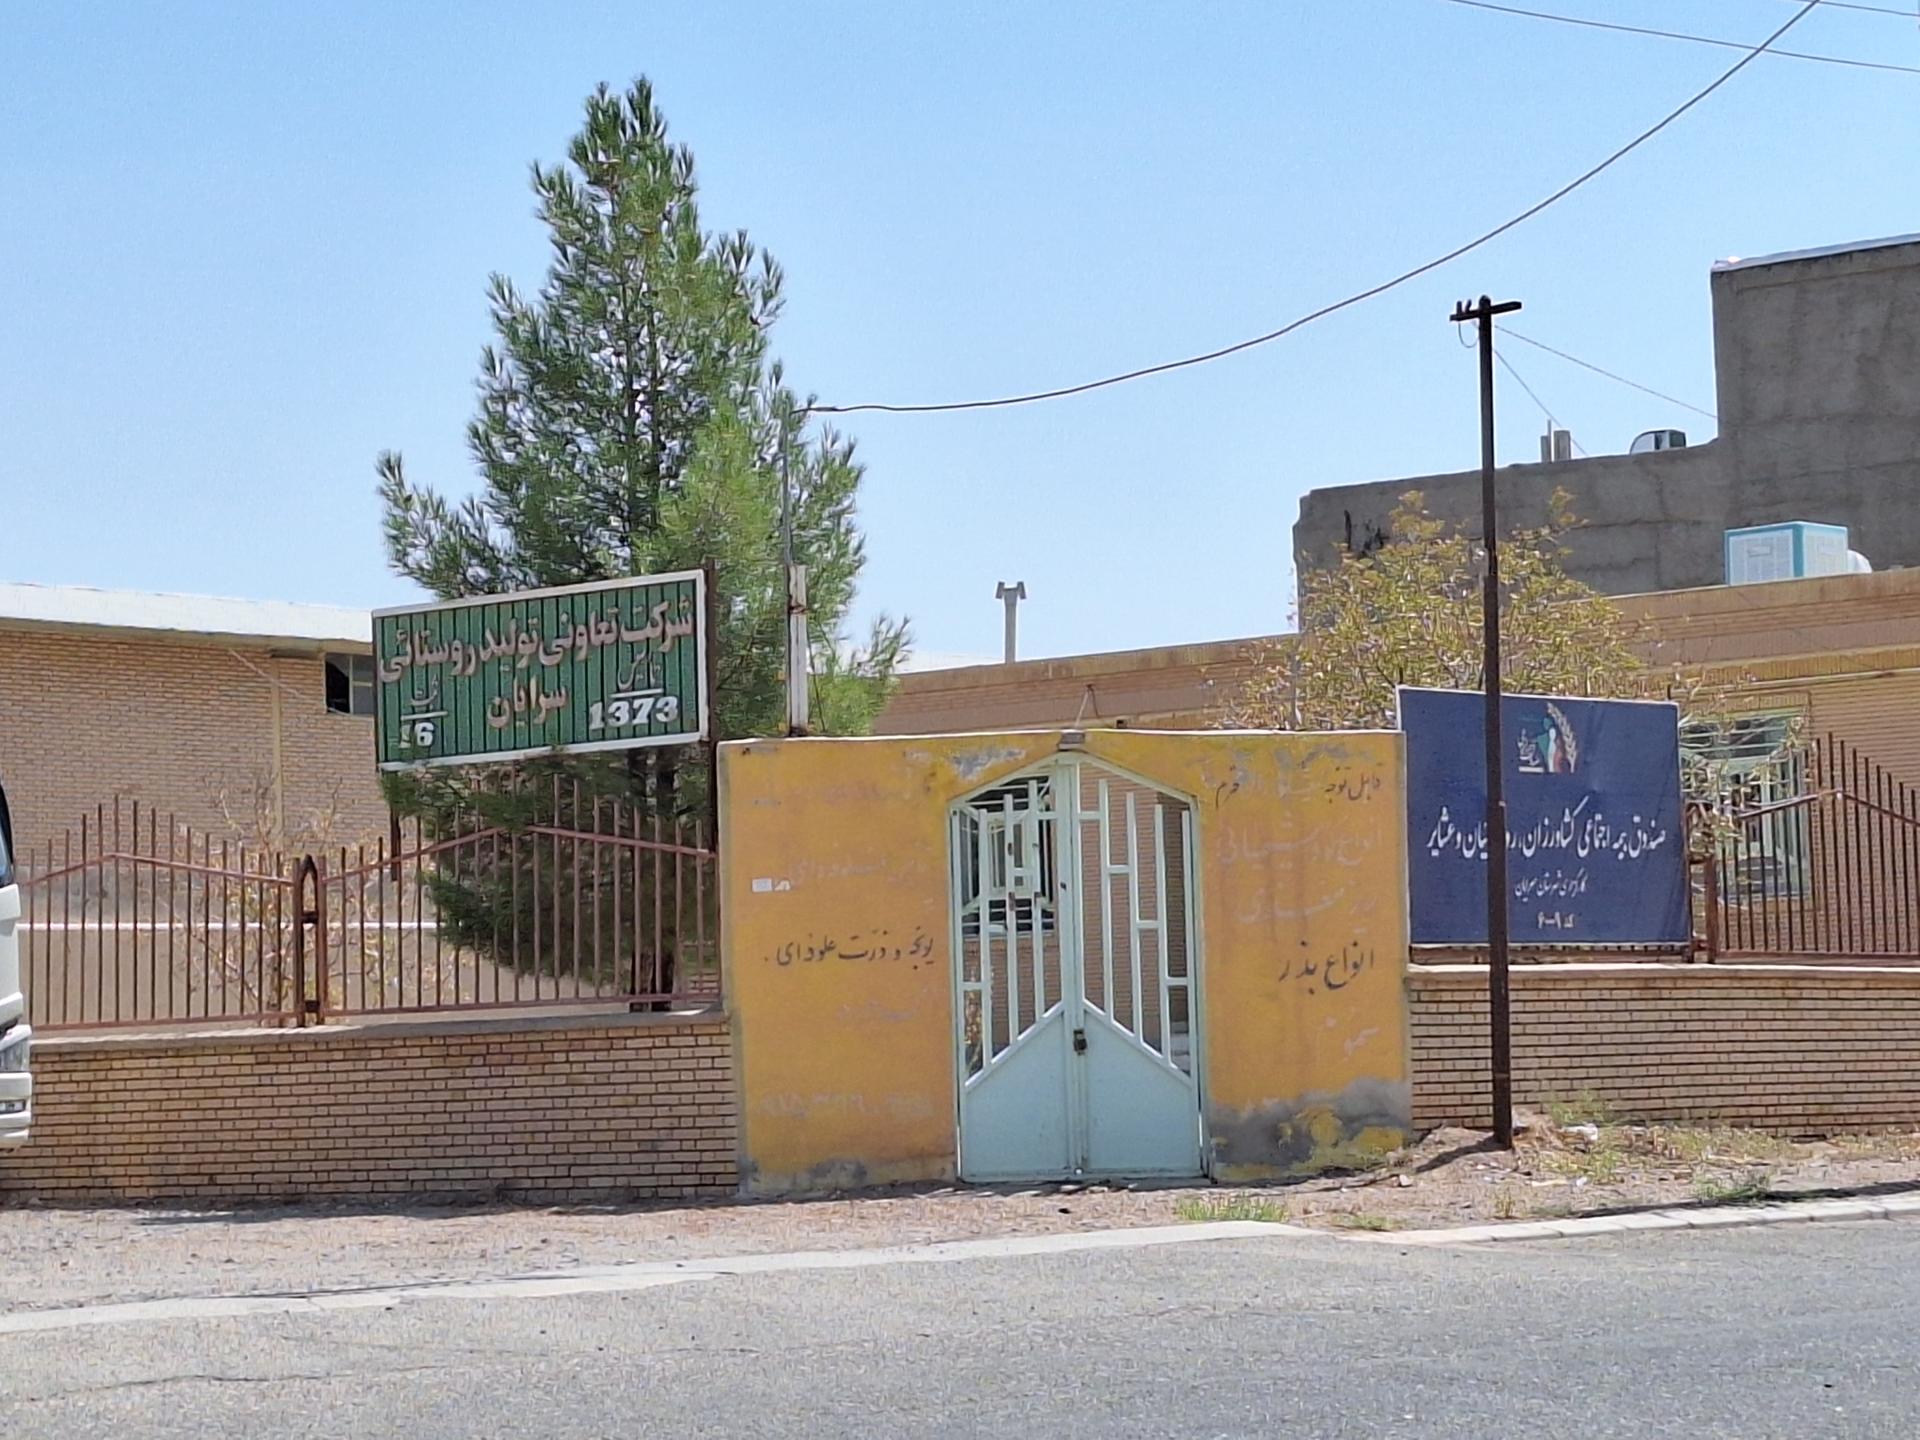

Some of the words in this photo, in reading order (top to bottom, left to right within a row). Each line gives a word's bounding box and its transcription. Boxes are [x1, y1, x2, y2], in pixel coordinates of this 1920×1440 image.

[479, 617, 540, 672] تولید
[537, 607, 619, 666] تعاونی
[618, 595, 694, 652] شرکت
[486, 675, 570, 729] سرایان
[588, 696, 680, 731] 1373
[1426, 805, 1456, 857] عشایر
[1454, 830, 1462, 850] و
[1576, 812, 1611, 859] اجتماعی
[1611, 831, 1628, 861] بیمه
[1627, 814, 1667, 859] صندوق
[1277, 939, 1319, 996] بذر
[1323, 939, 1375, 991] انواع
